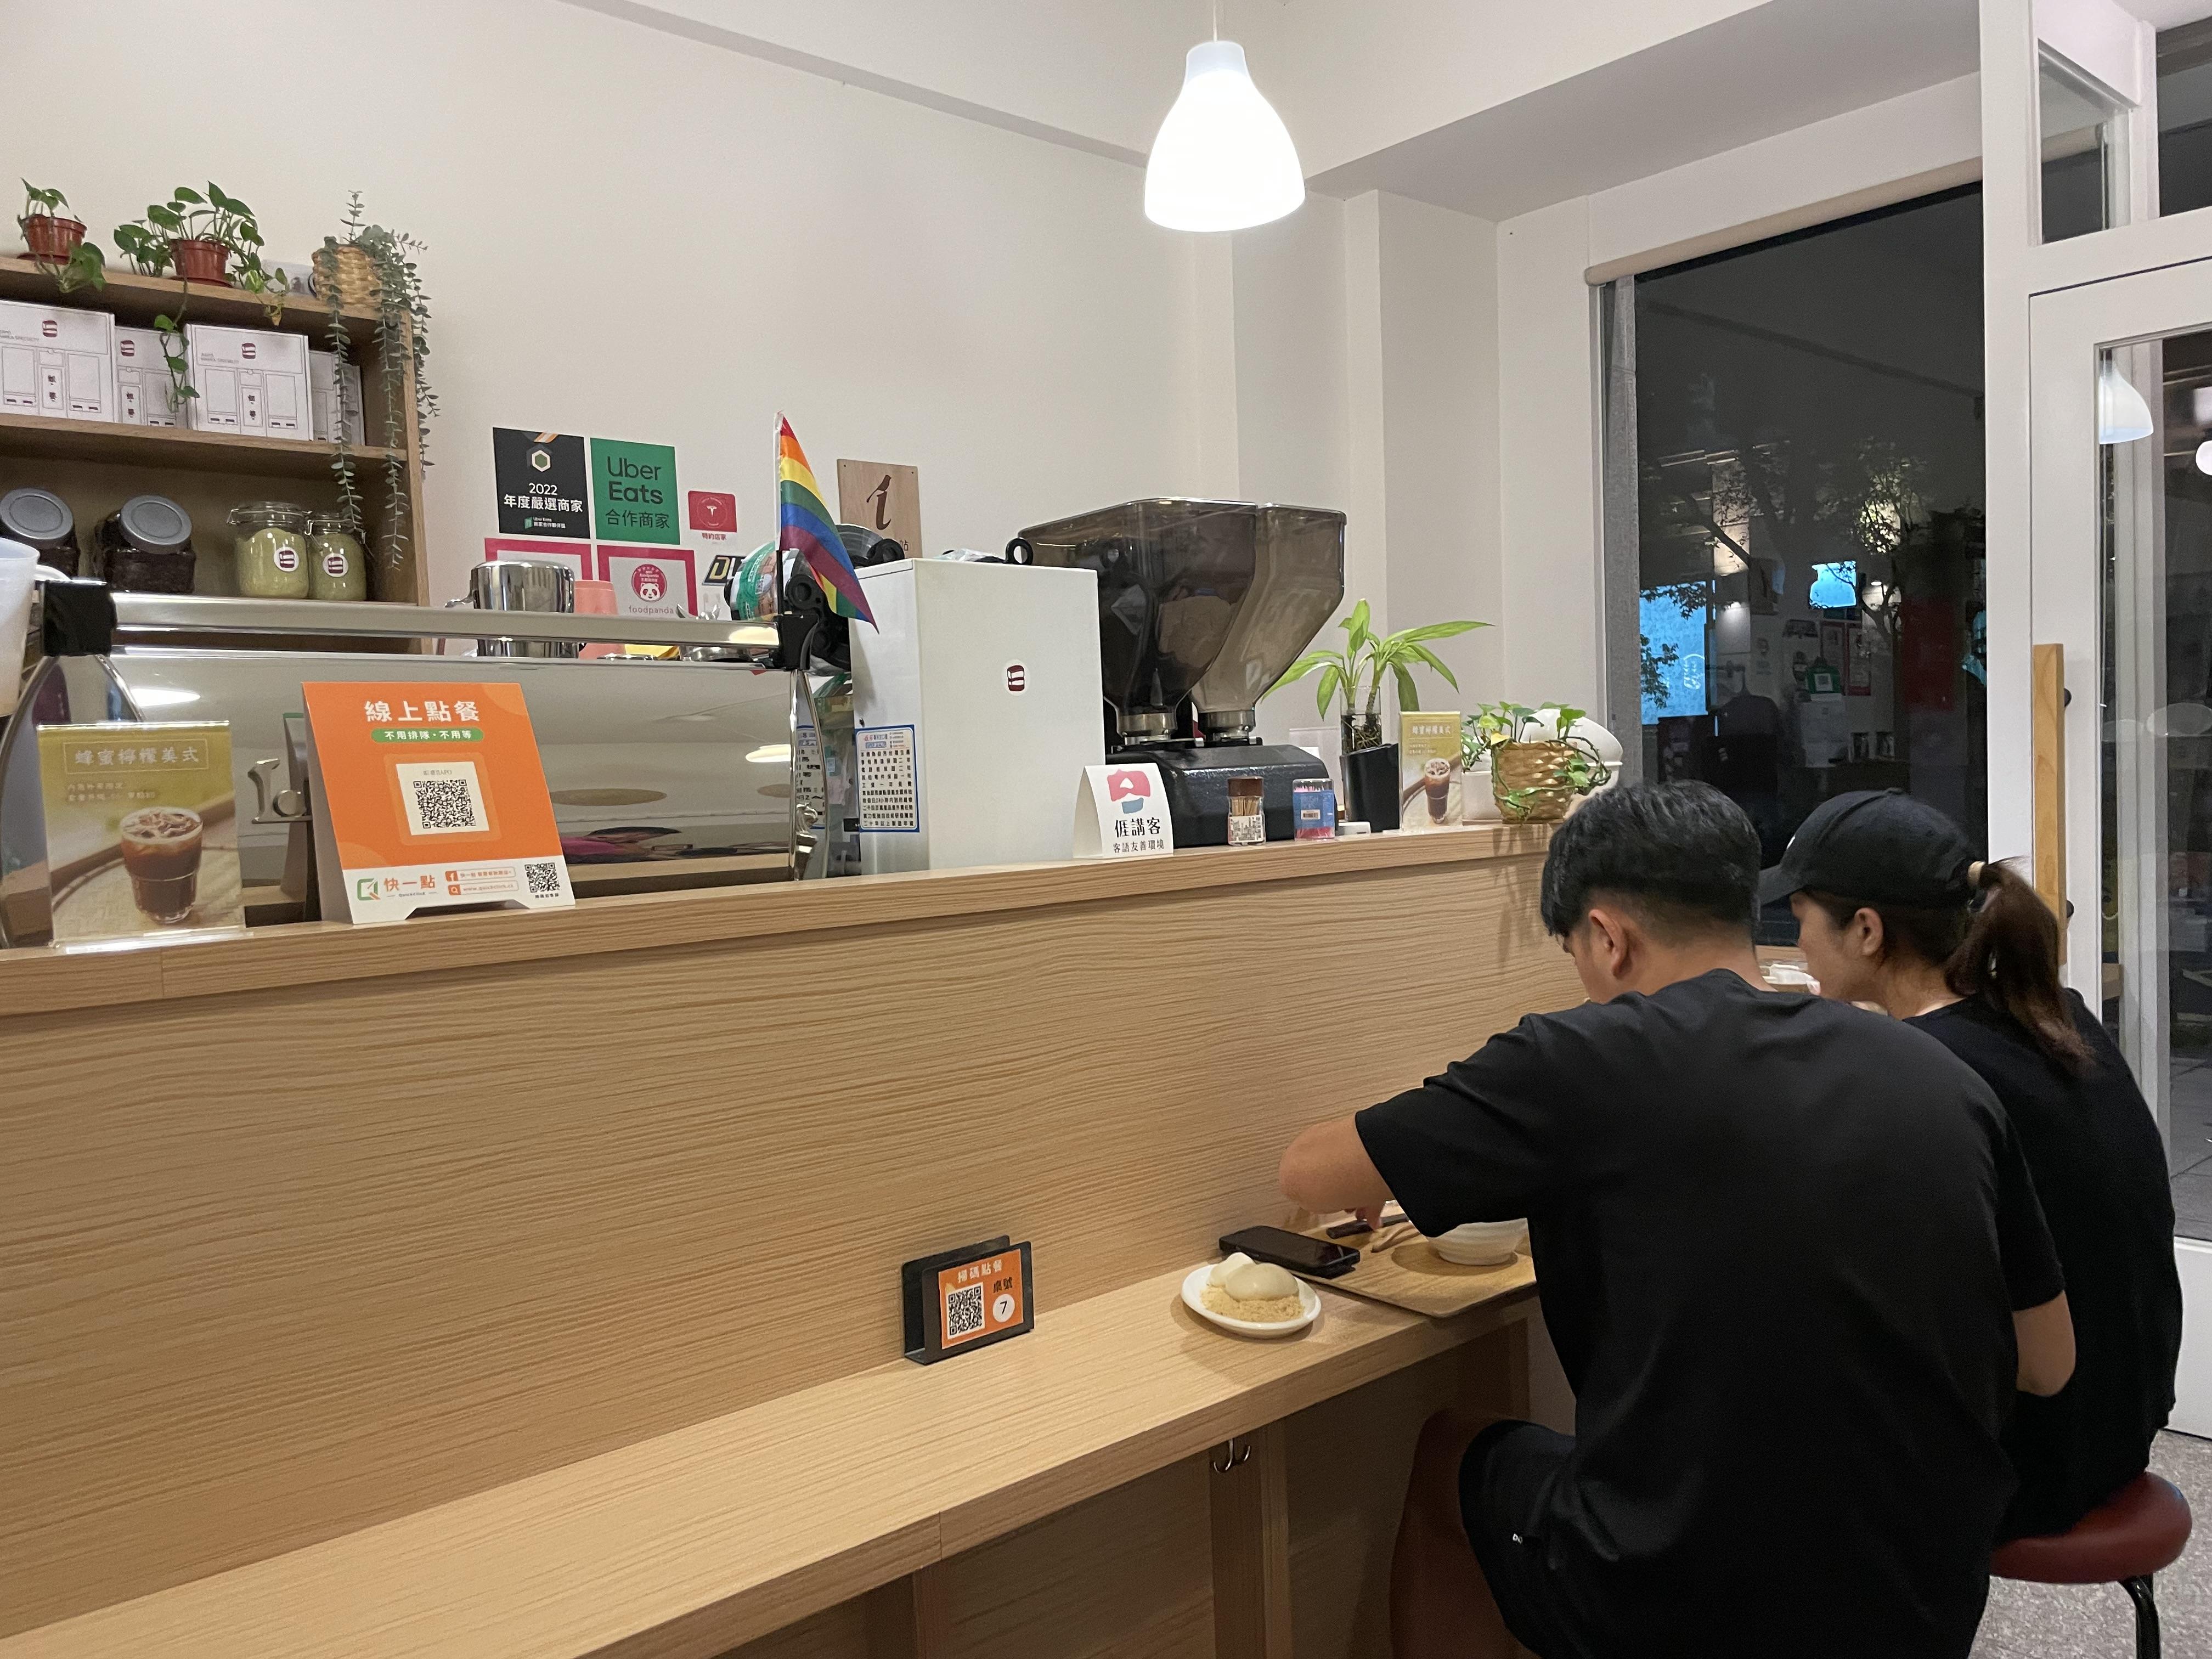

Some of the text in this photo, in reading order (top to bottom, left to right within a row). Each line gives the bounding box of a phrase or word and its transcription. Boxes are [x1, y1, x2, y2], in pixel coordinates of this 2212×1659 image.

[607, 456, 662, 481] Uber
[528, 483, 558, 495] 2022
[608, 481, 663, 505] Eats
[504, 494, 583, 513] 年度嚴選商家
[605, 509, 670, 529] 合作商家
[629, 605, 674, 615] foodpanda
[364, 701, 480, 722] 線上點餐
[75, 746, 199, 766] 蜂蜜檸檬美式
[1113, 839, 1164, 854] 客語友善環境
[383, 874, 436, 892] 快一點
[957, 1259, 1002, 1284] 掃碼點餐
[993, 1276, 1013, 1294] 桌號
[1000, 1300, 1007, 1314] 7
